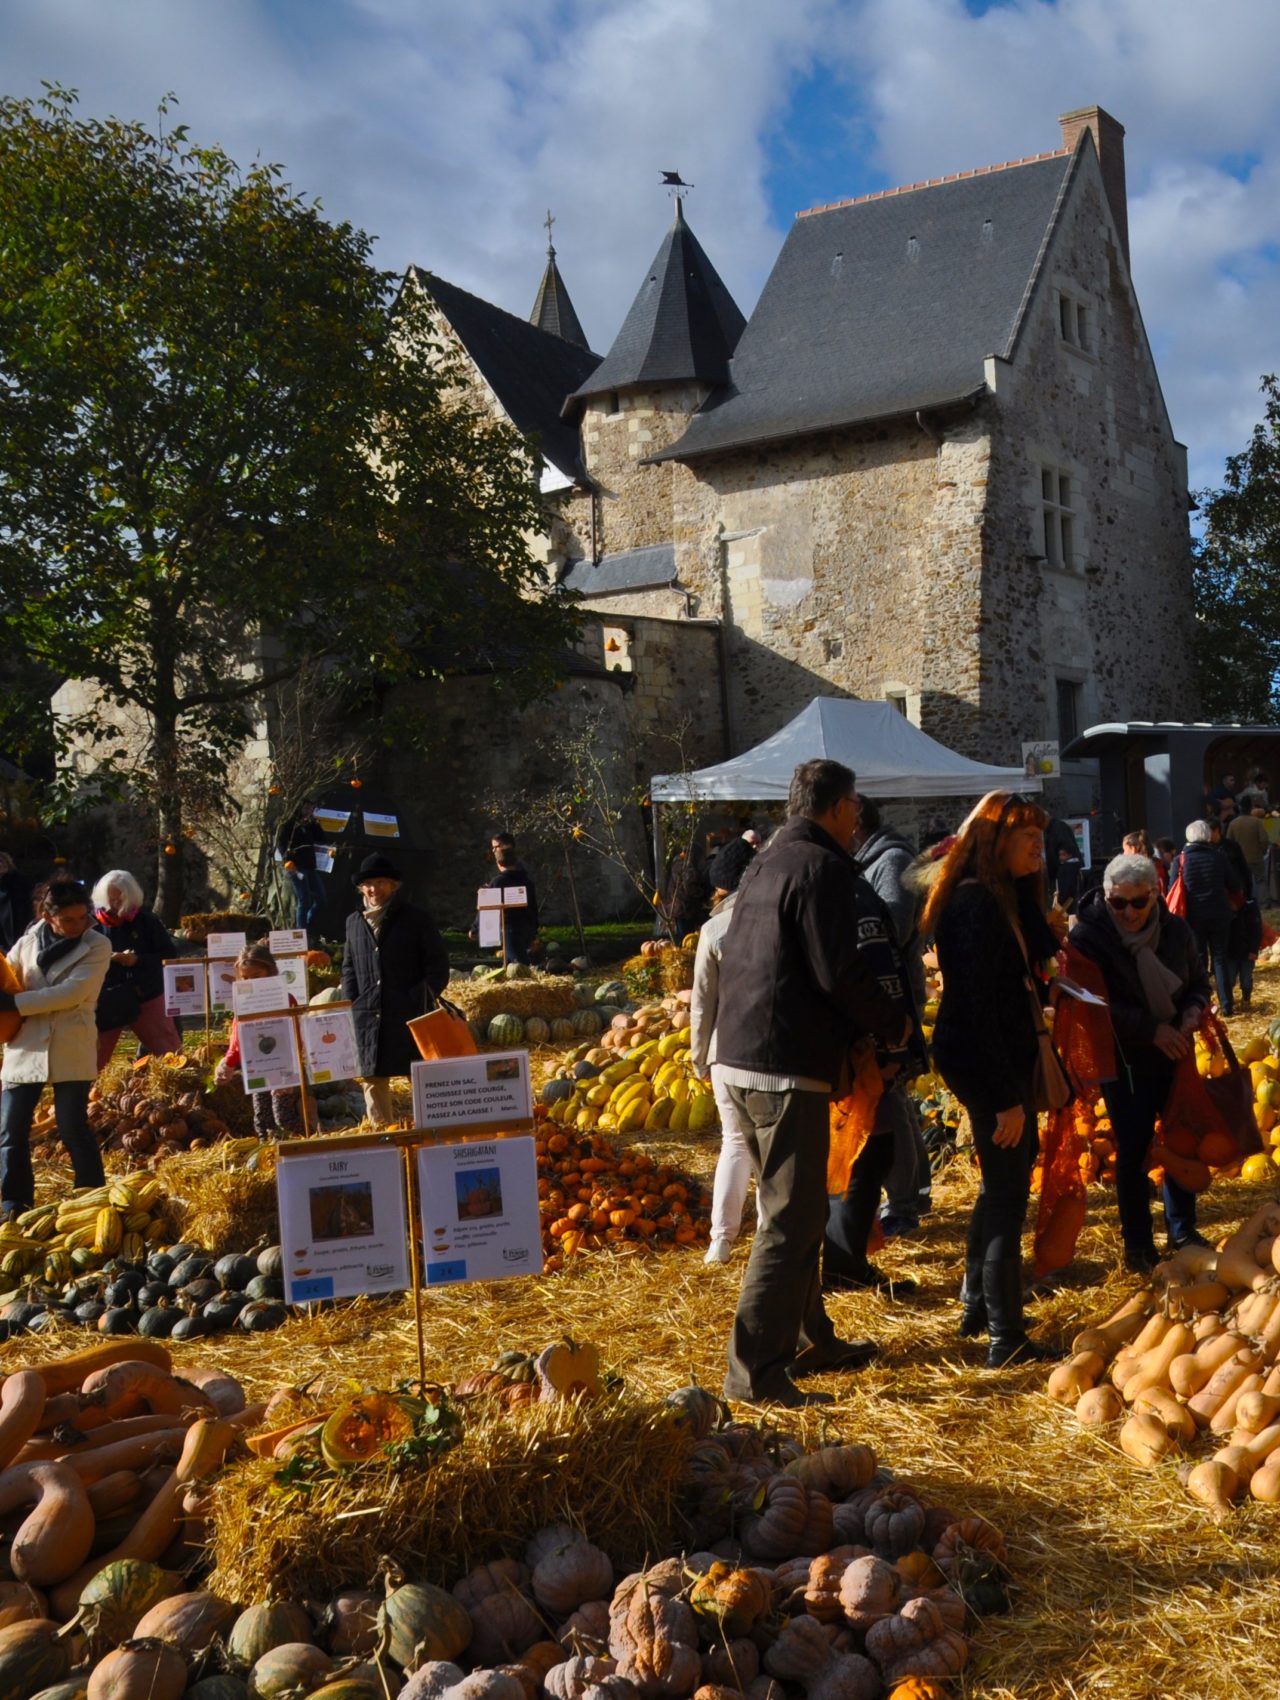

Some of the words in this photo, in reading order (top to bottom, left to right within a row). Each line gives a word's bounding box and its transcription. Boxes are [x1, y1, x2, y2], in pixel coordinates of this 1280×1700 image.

[425, 1080, 449, 1089] PRENEZ
[426, 1089, 461, 1099] CHOISISSEZ
[478, 1085, 506, 1093] COURGE,
[426, 1101, 448, 1109] NOTEZ
[483, 1095, 514, 1103] COULEUR,
[427, 1111, 450, 1119] PASSEZ
[328, 1160, 348, 1172] FAIRY
